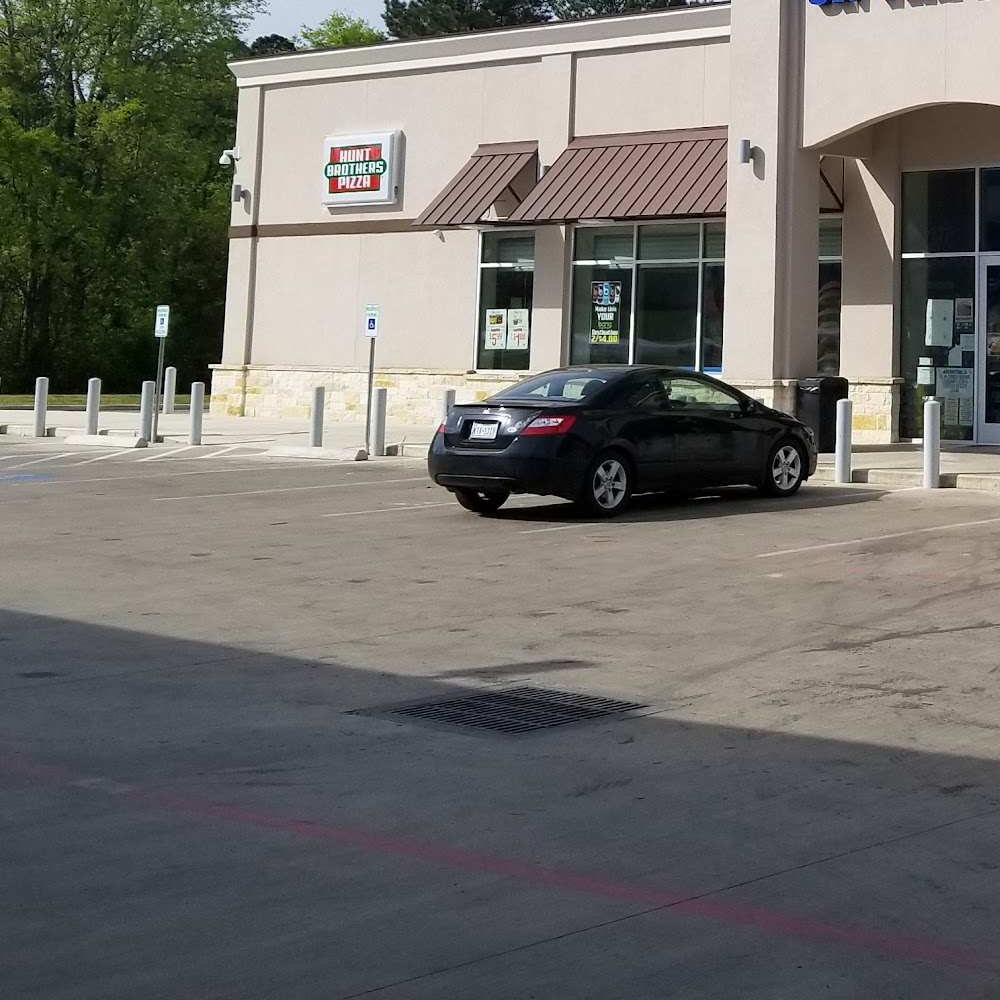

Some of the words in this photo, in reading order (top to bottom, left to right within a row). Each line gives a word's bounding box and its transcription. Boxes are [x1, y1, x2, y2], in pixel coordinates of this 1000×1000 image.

[340, 148, 371, 163] HUNT
[326, 161, 384, 177] BROTHERS
[337, 175, 371, 190] PIZZA
[597, 312, 614, 321] YOUR
